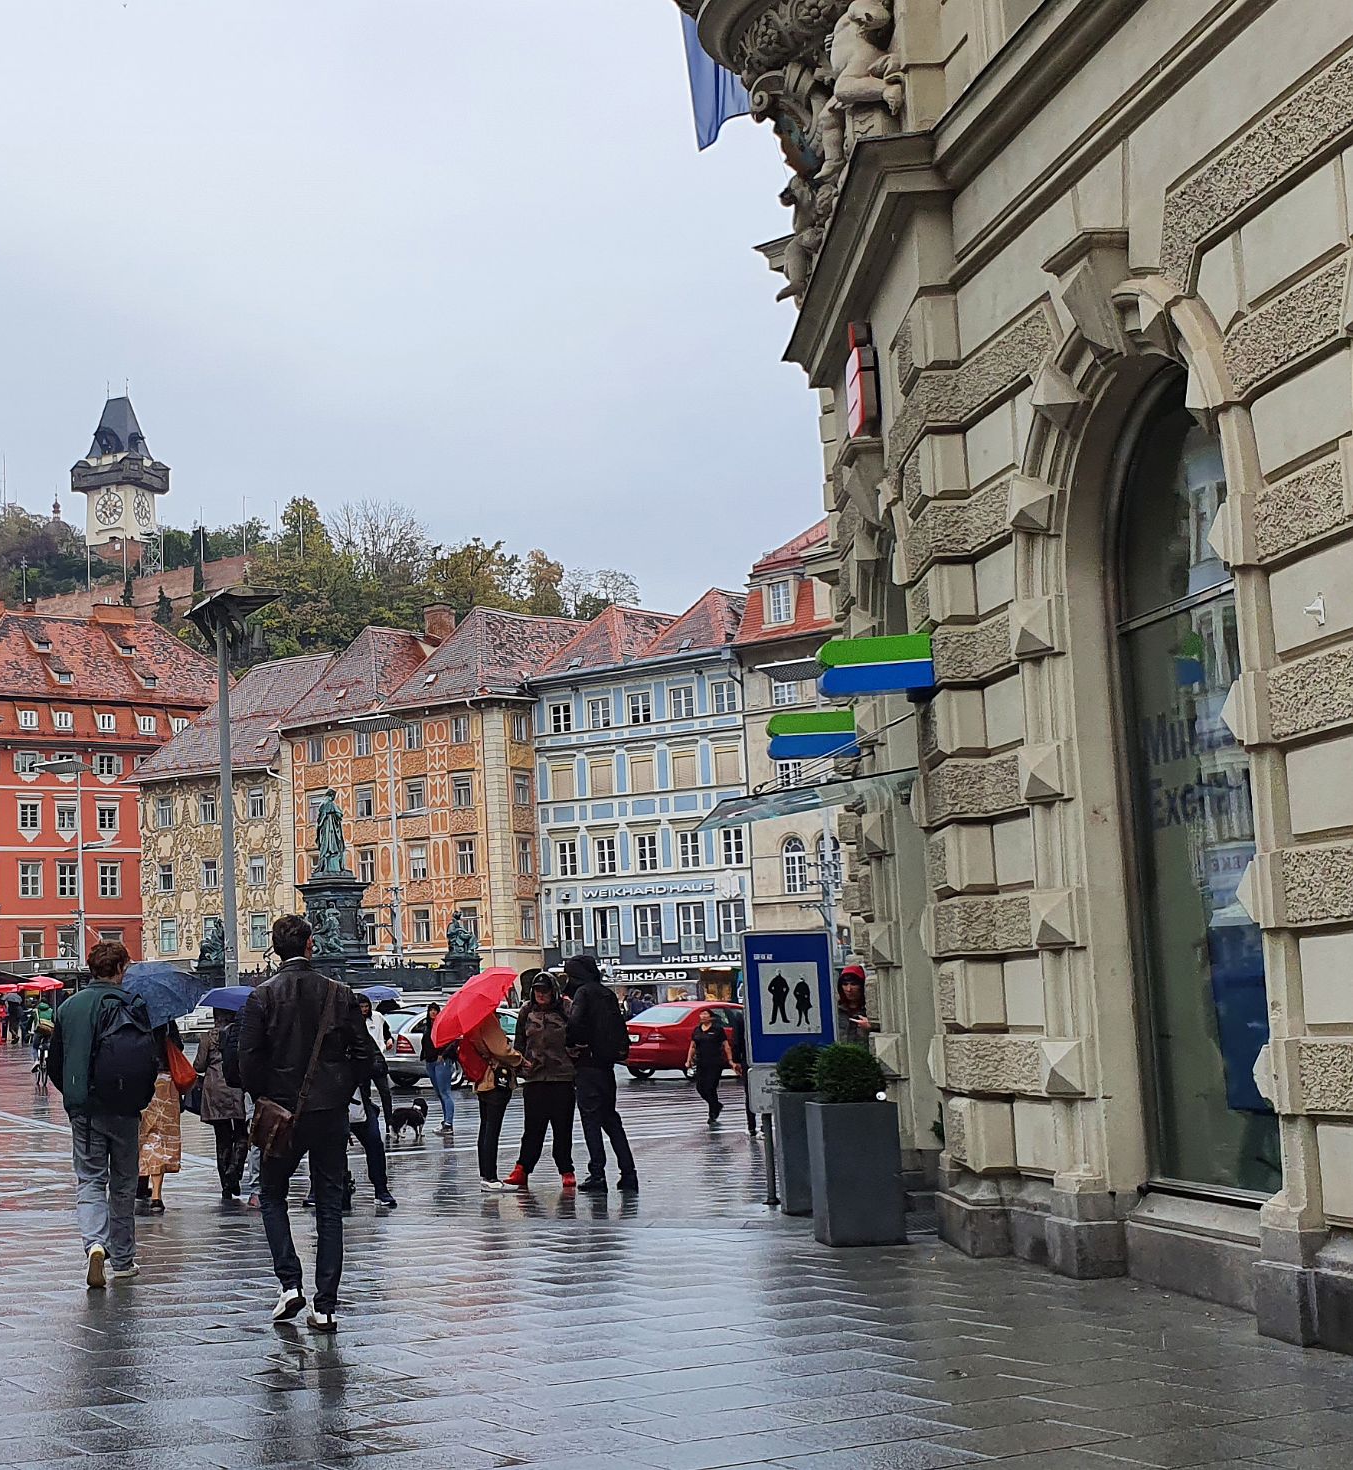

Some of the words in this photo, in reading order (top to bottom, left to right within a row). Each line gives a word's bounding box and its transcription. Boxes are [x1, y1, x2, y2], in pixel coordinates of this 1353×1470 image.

[583, 884, 667, 898] WEIKHARD
[670, 882, 715, 893] HAUS
[66, 961, 76, 969] 12
